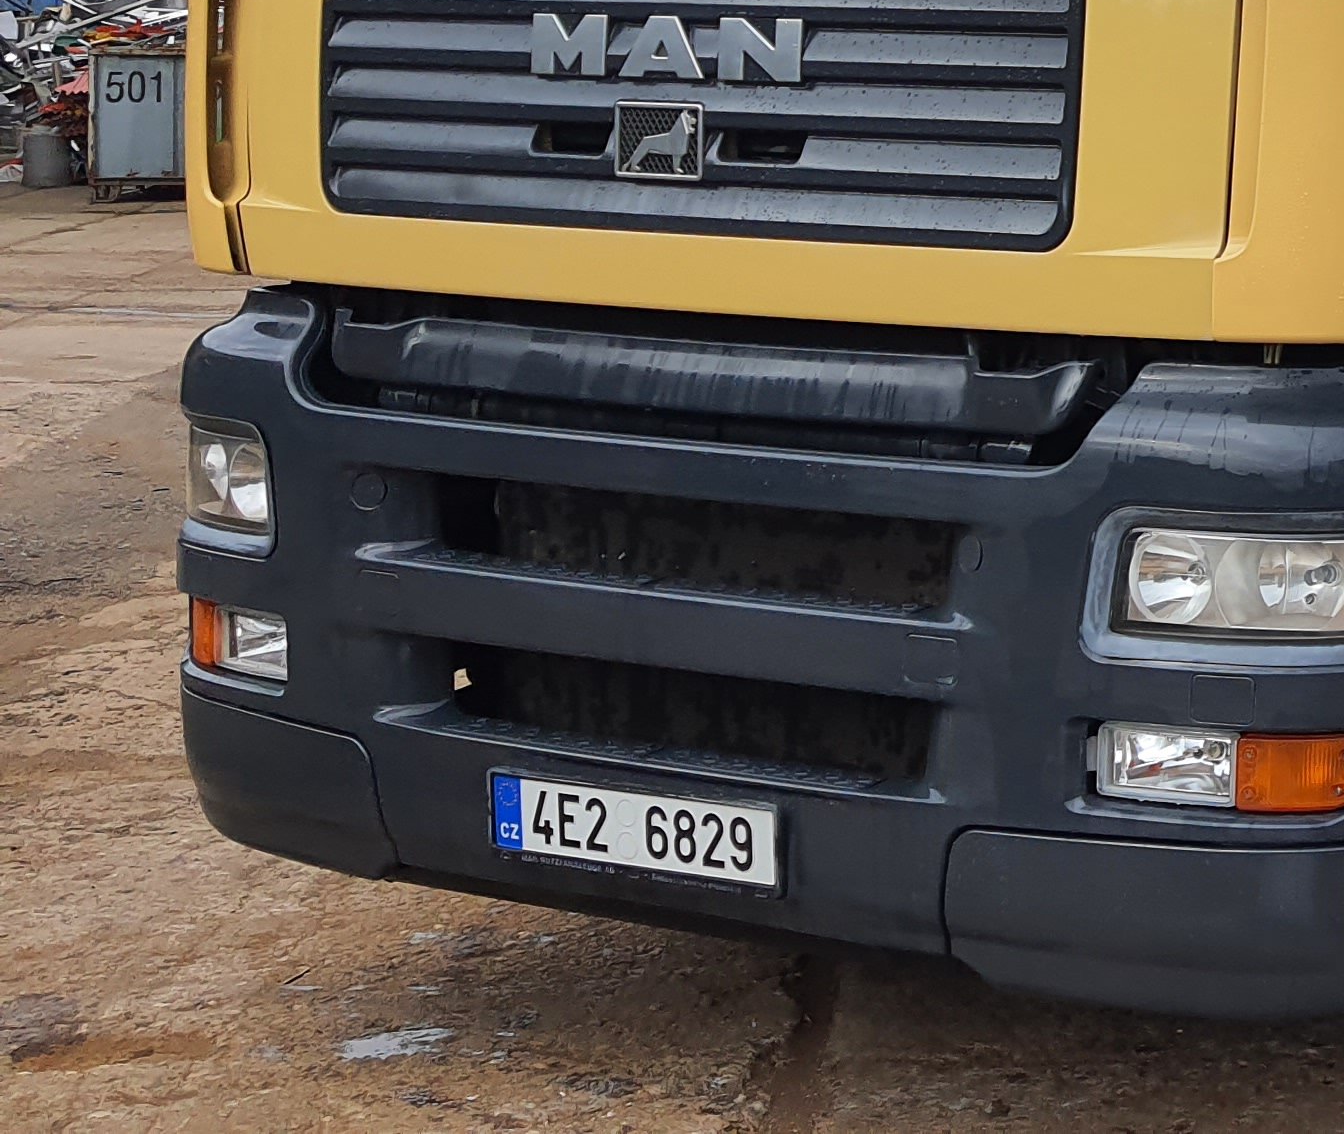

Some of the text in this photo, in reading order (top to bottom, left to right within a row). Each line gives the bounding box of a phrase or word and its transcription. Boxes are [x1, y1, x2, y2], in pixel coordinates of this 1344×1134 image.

[530, 13, 803, 83] MAN
[105, 70, 162, 104] 501
[499, 822, 520, 841] CZ
[531, 790, 754, 873] 4E2 6829
